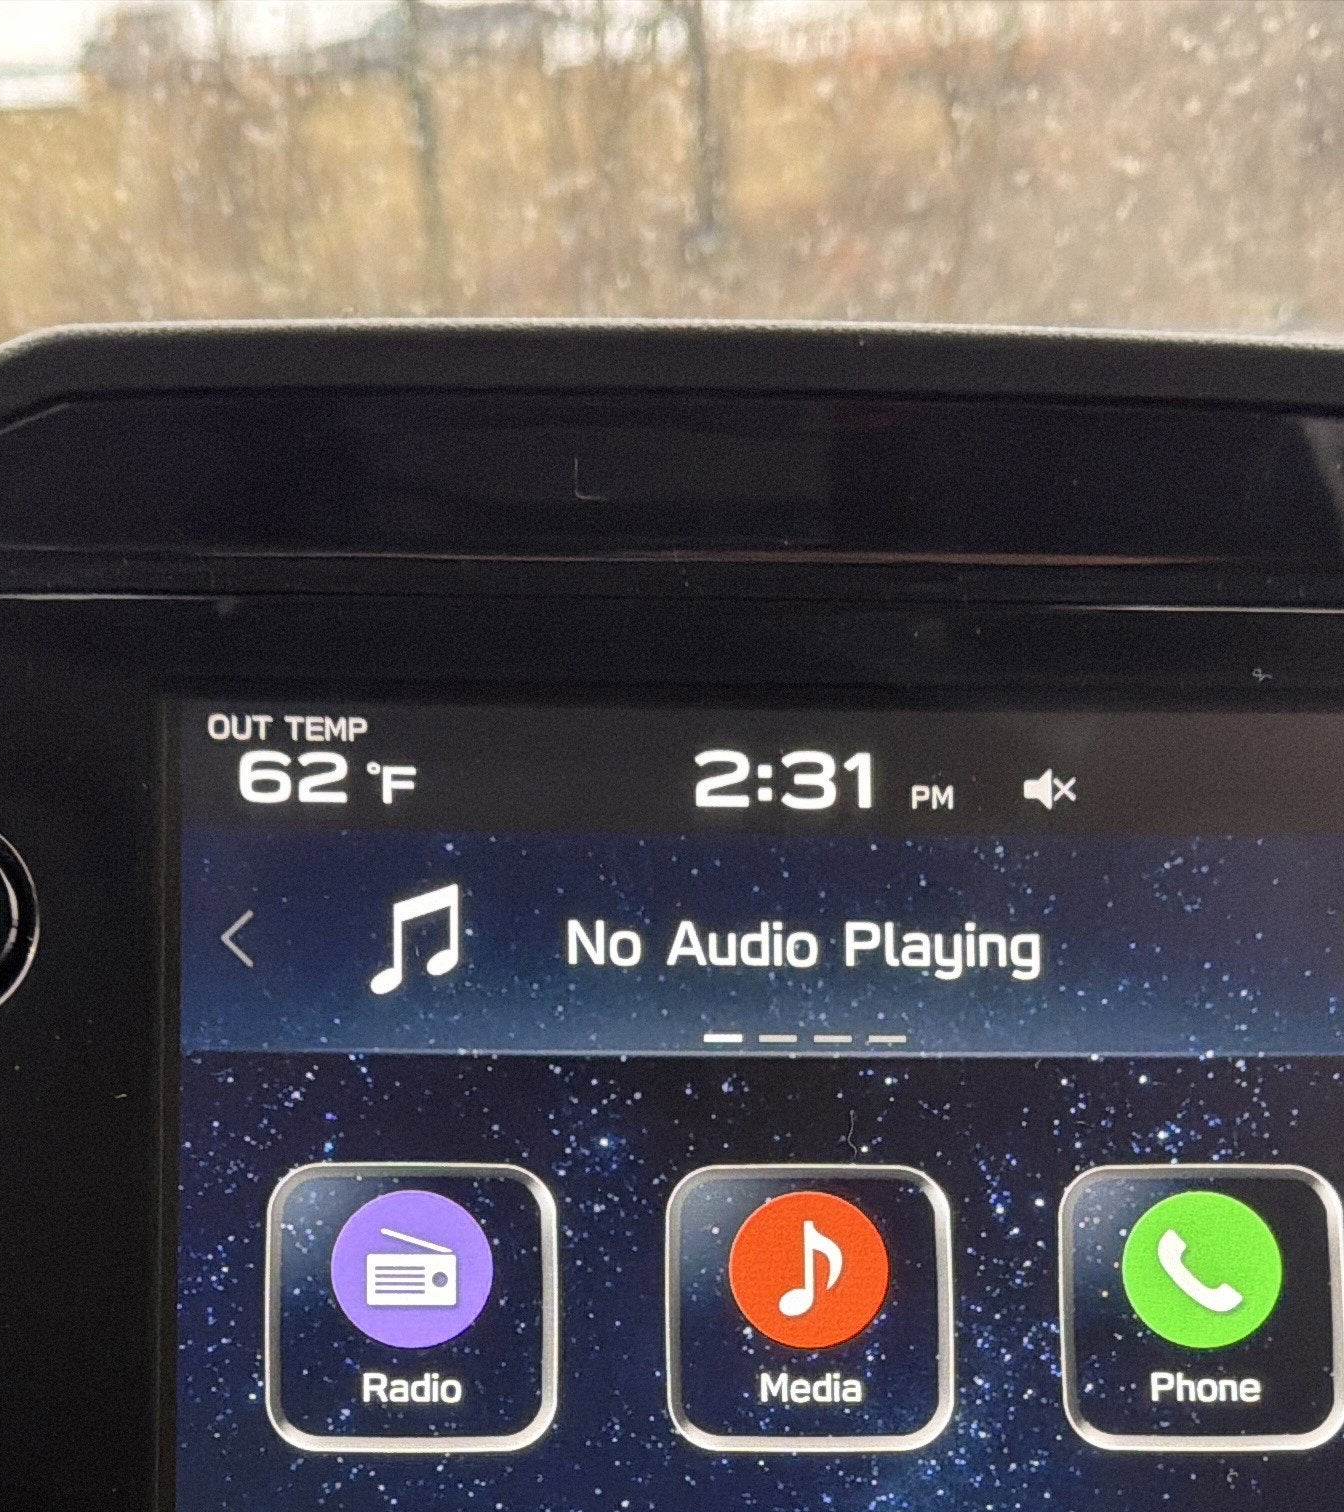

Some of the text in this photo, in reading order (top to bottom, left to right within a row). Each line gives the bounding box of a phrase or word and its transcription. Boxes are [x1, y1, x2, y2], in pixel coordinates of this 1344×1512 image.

[207, 713, 368, 742] OUT TEMP
[238, 749, 349, 804] 62
[693, 748, 955, 811] 2:31 PM
[567, 918, 1042, 981] No Audio Playing
[361, 1371, 463, 1405] Radio
[759, 1371, 864, 1405] Media
[1149, 1370, 1263, 1404] Phone
